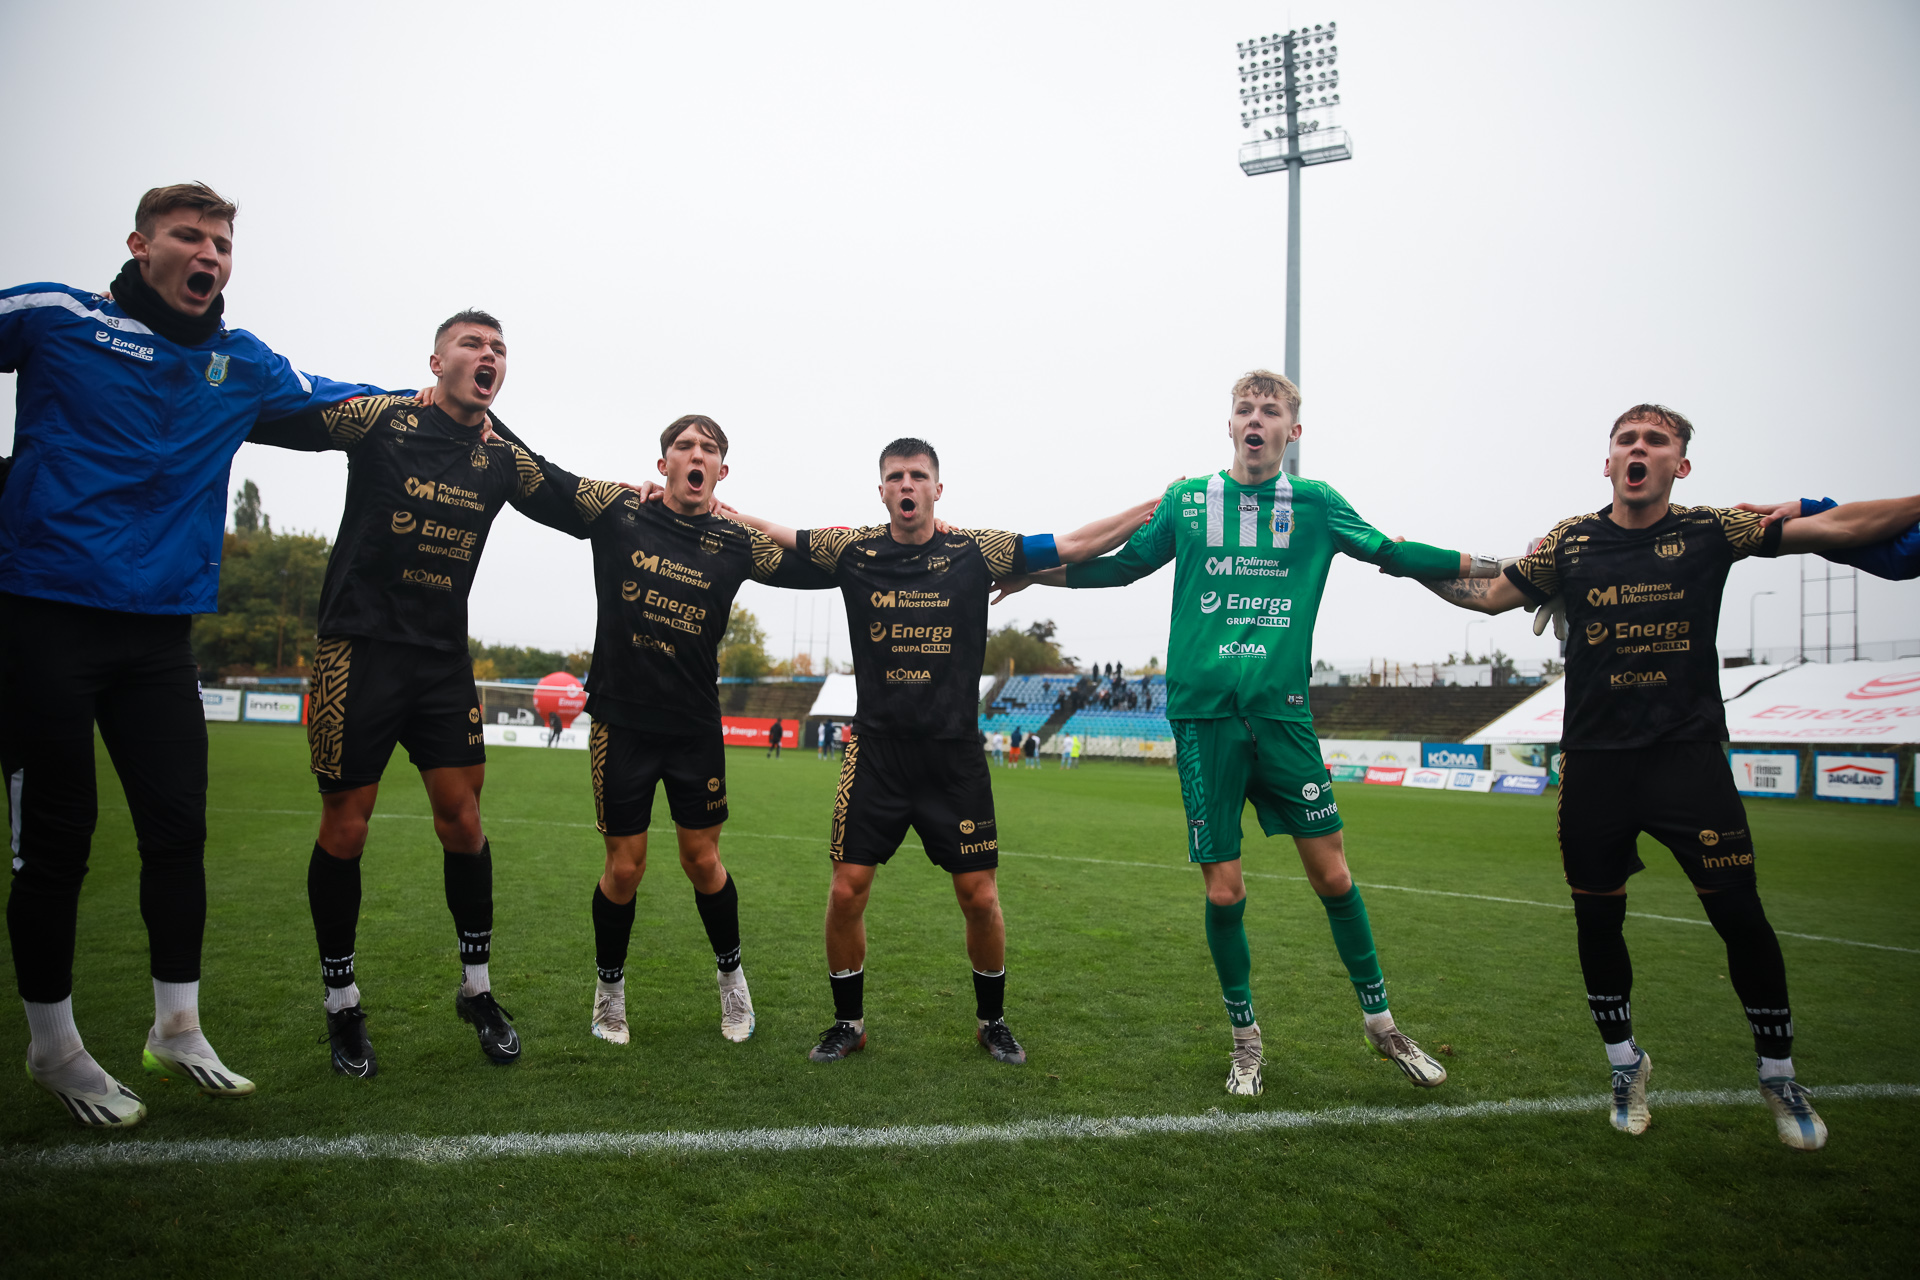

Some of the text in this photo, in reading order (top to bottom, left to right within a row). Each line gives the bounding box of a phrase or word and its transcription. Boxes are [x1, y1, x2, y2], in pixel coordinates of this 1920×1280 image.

[112, 338, 154, 355] Energa
[438, 483, 479, 500] Polimex
[436, 493, 485, 512] Mostostal
[418, 543, 448, 555] GRUPA
[661, 558, 704, 579] Polimex
[1235, 556, 1280, 567] Polimex
[403, 569, 453, 587] KOMA
[659, 567, 711, 590] Mostostal
[1235, 565, 1289, 577] Mostostal
[898, 590, 940, 599] Polimex
[1621, 582, 1672, 595] Polimex
[898, 599, 950, 608] Mostostal
[1227, 594, 1292, 615] Energa
[1621, 590, 1684, 604] Mostostal
[645, 589, 707, 621] Energa
[642, 610, 701, 634] GRUPA ORLEN
[1226, 617, 1289, 627] GRUPA ORLEN
[891, 624, 953, 642] Energa
[1616, 621, 1690, 640] Energa
[632, 633, 676, 654] KOMA
[891, 644, 950, 653] GRUPA ORLEN
[1219, 641, 1267, 654] KOMA
[1616, 641, 1688, 654] GRUPA ORLEN
[886, 668, 931, 681] KOMA
[1610, 671, 1667, 684] KOMA
[559, 697, 583, 708] Energ
[1428, 750, 1477, 765] KOMA
[707, 795, 727, 811] innt
[1306, 803, 1337, 821] innte
